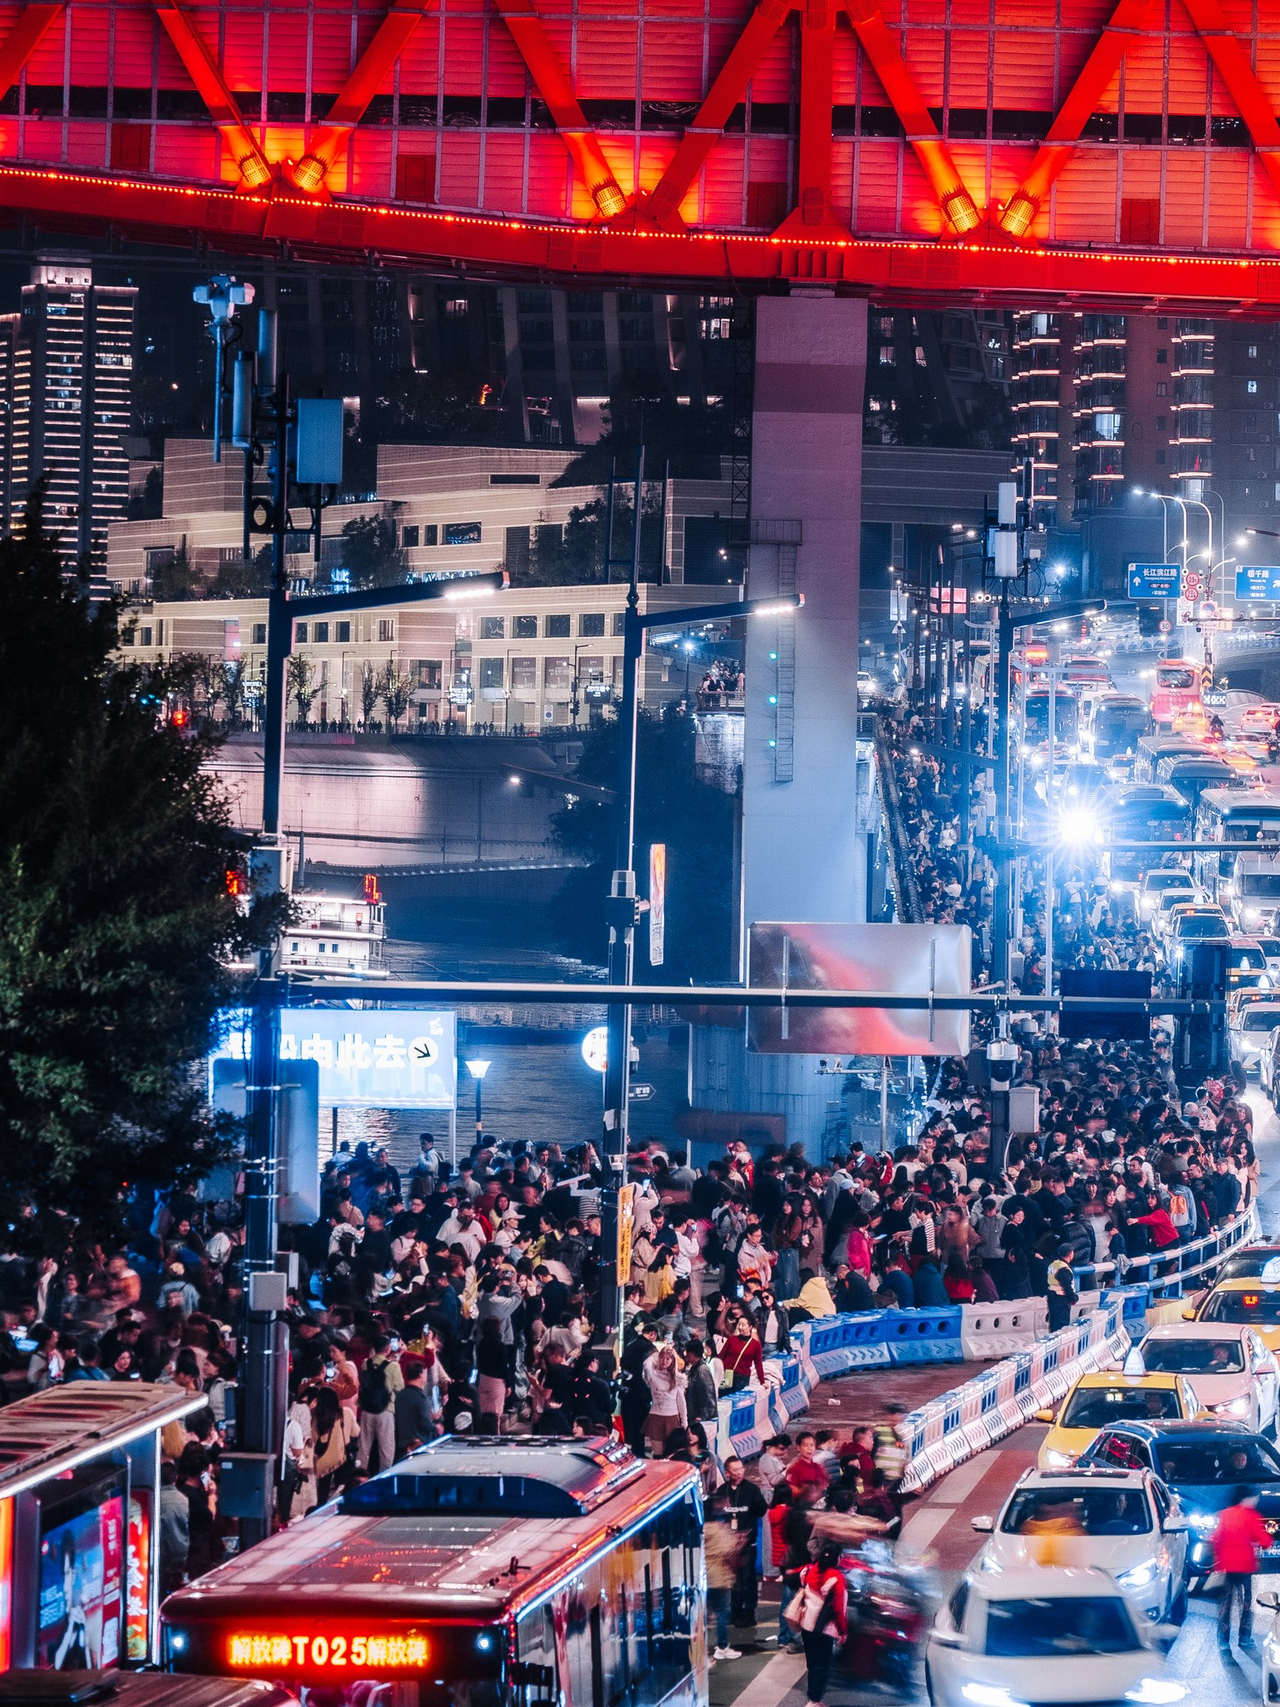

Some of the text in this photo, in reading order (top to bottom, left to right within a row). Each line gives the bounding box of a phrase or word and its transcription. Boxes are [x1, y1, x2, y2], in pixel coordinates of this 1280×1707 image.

[1143, 568, 1178, 577] 长江滨江路
